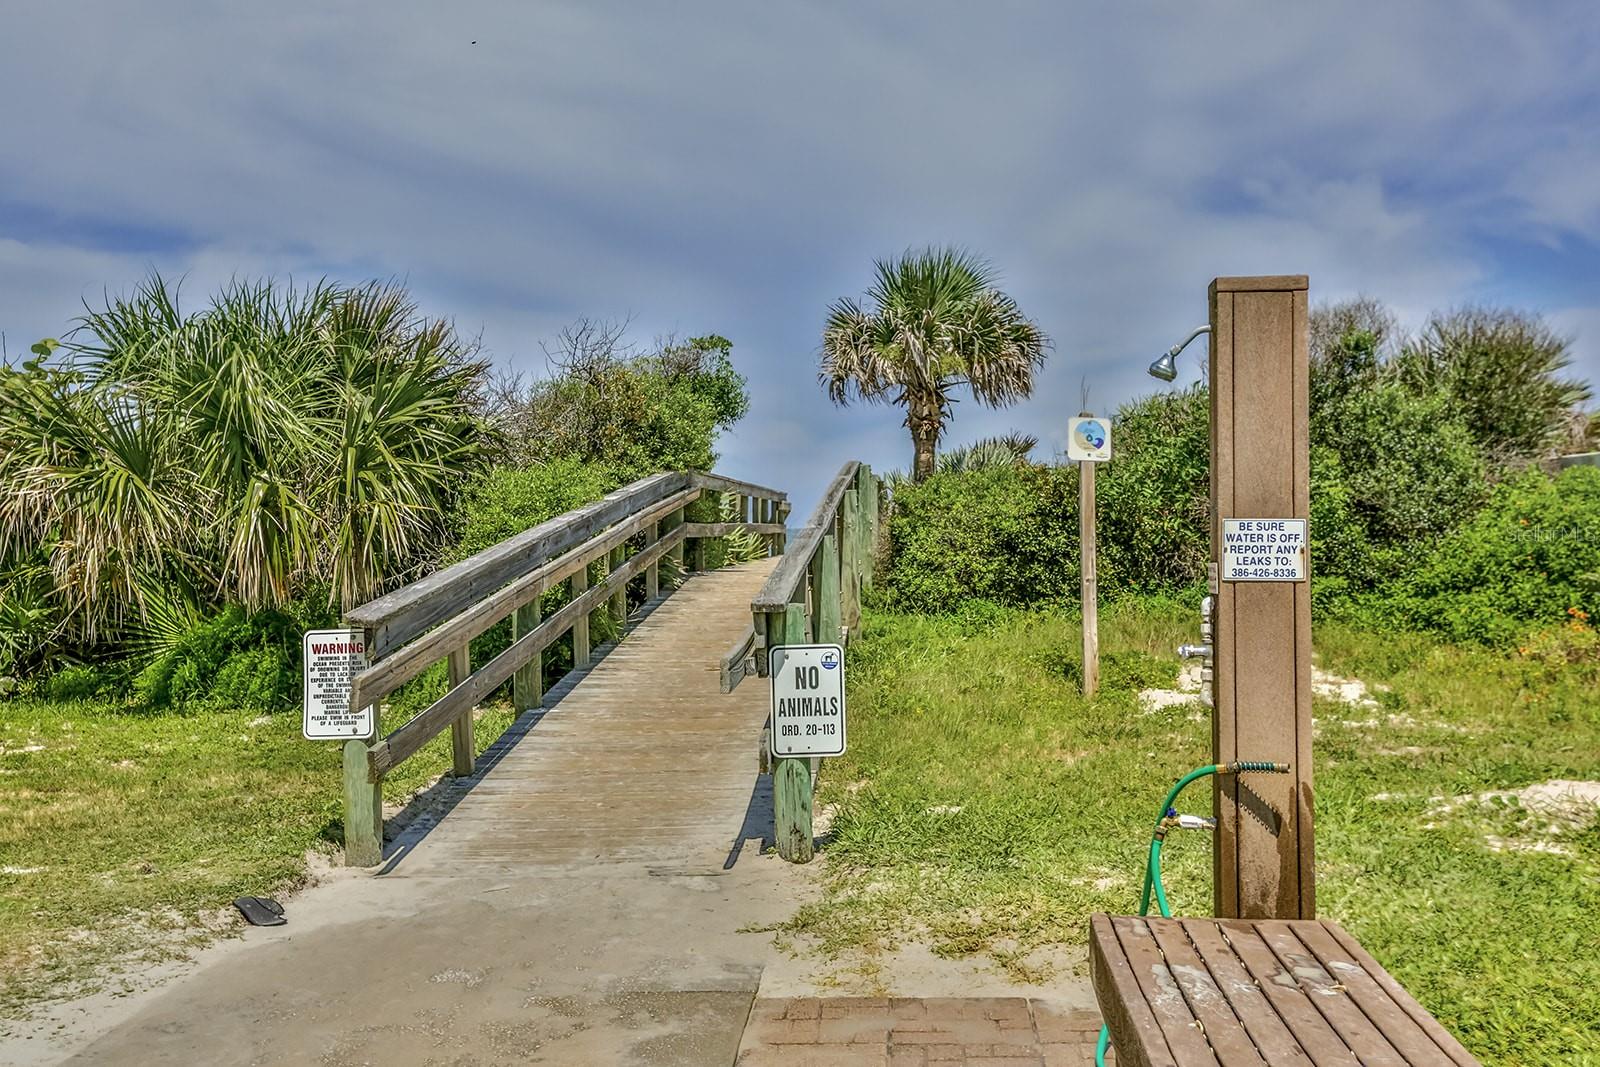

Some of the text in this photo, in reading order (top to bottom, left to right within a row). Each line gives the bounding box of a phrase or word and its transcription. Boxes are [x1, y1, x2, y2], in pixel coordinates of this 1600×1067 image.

[1239, 522, 1284, 531] BE SURE
[1226, 534, 1263, 542] WATER
[1267, 534, 1276, 542] IS
[1230, 545, 1298, 554] REPORT ANY
[1236, 557, 1292, 566] LEAKS TO:
[1232, 569, 1296, 577] 386-426-8336
[312, 642, 364, 654] WARNING
[795, 666, 819, 690] NO
[779, 696, 838, 717] ANIMALS
[782, 724, 835, 736] ORD. 20-113
